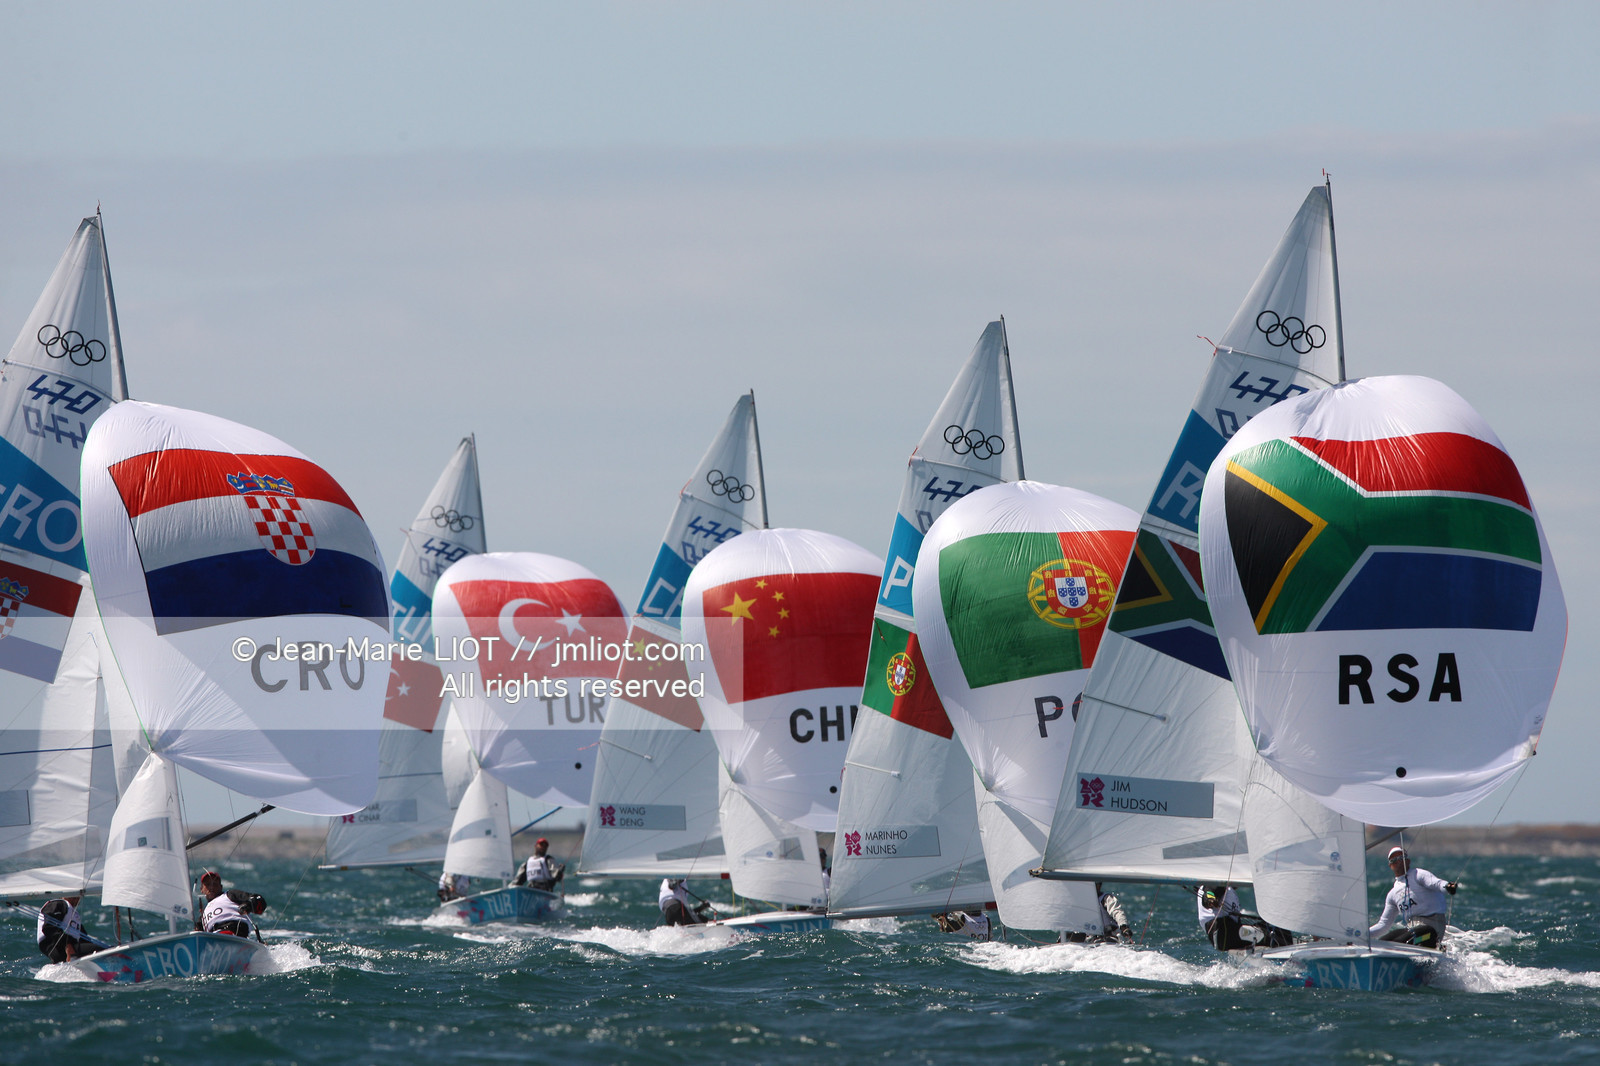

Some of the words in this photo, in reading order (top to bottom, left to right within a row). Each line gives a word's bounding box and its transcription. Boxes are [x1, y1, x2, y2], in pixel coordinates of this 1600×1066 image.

[27, 375, 101, 415] 470
[0, 483, 82, 552] RO
[422, 538, 468, 563] 470
[251, 641, 365, 693] CRO
[1338, 652, 1462, 704] RSA
[539, 692, 605, 726] TUR
[1111, 780, 1131, 793] JIM
[619, 806, 646, 816] WANG
[1110, 797, 1168, 812] HUDSON
[619, 818, 645, 827] DENG
[865, 829, 908, 841] MARINHO
[866, 844, 897, 855] NUNES
[484, 894, 513, 918] TUR
[142, 942, 194, 980] CRO
[1316, 961, 1361, 991] RSA
